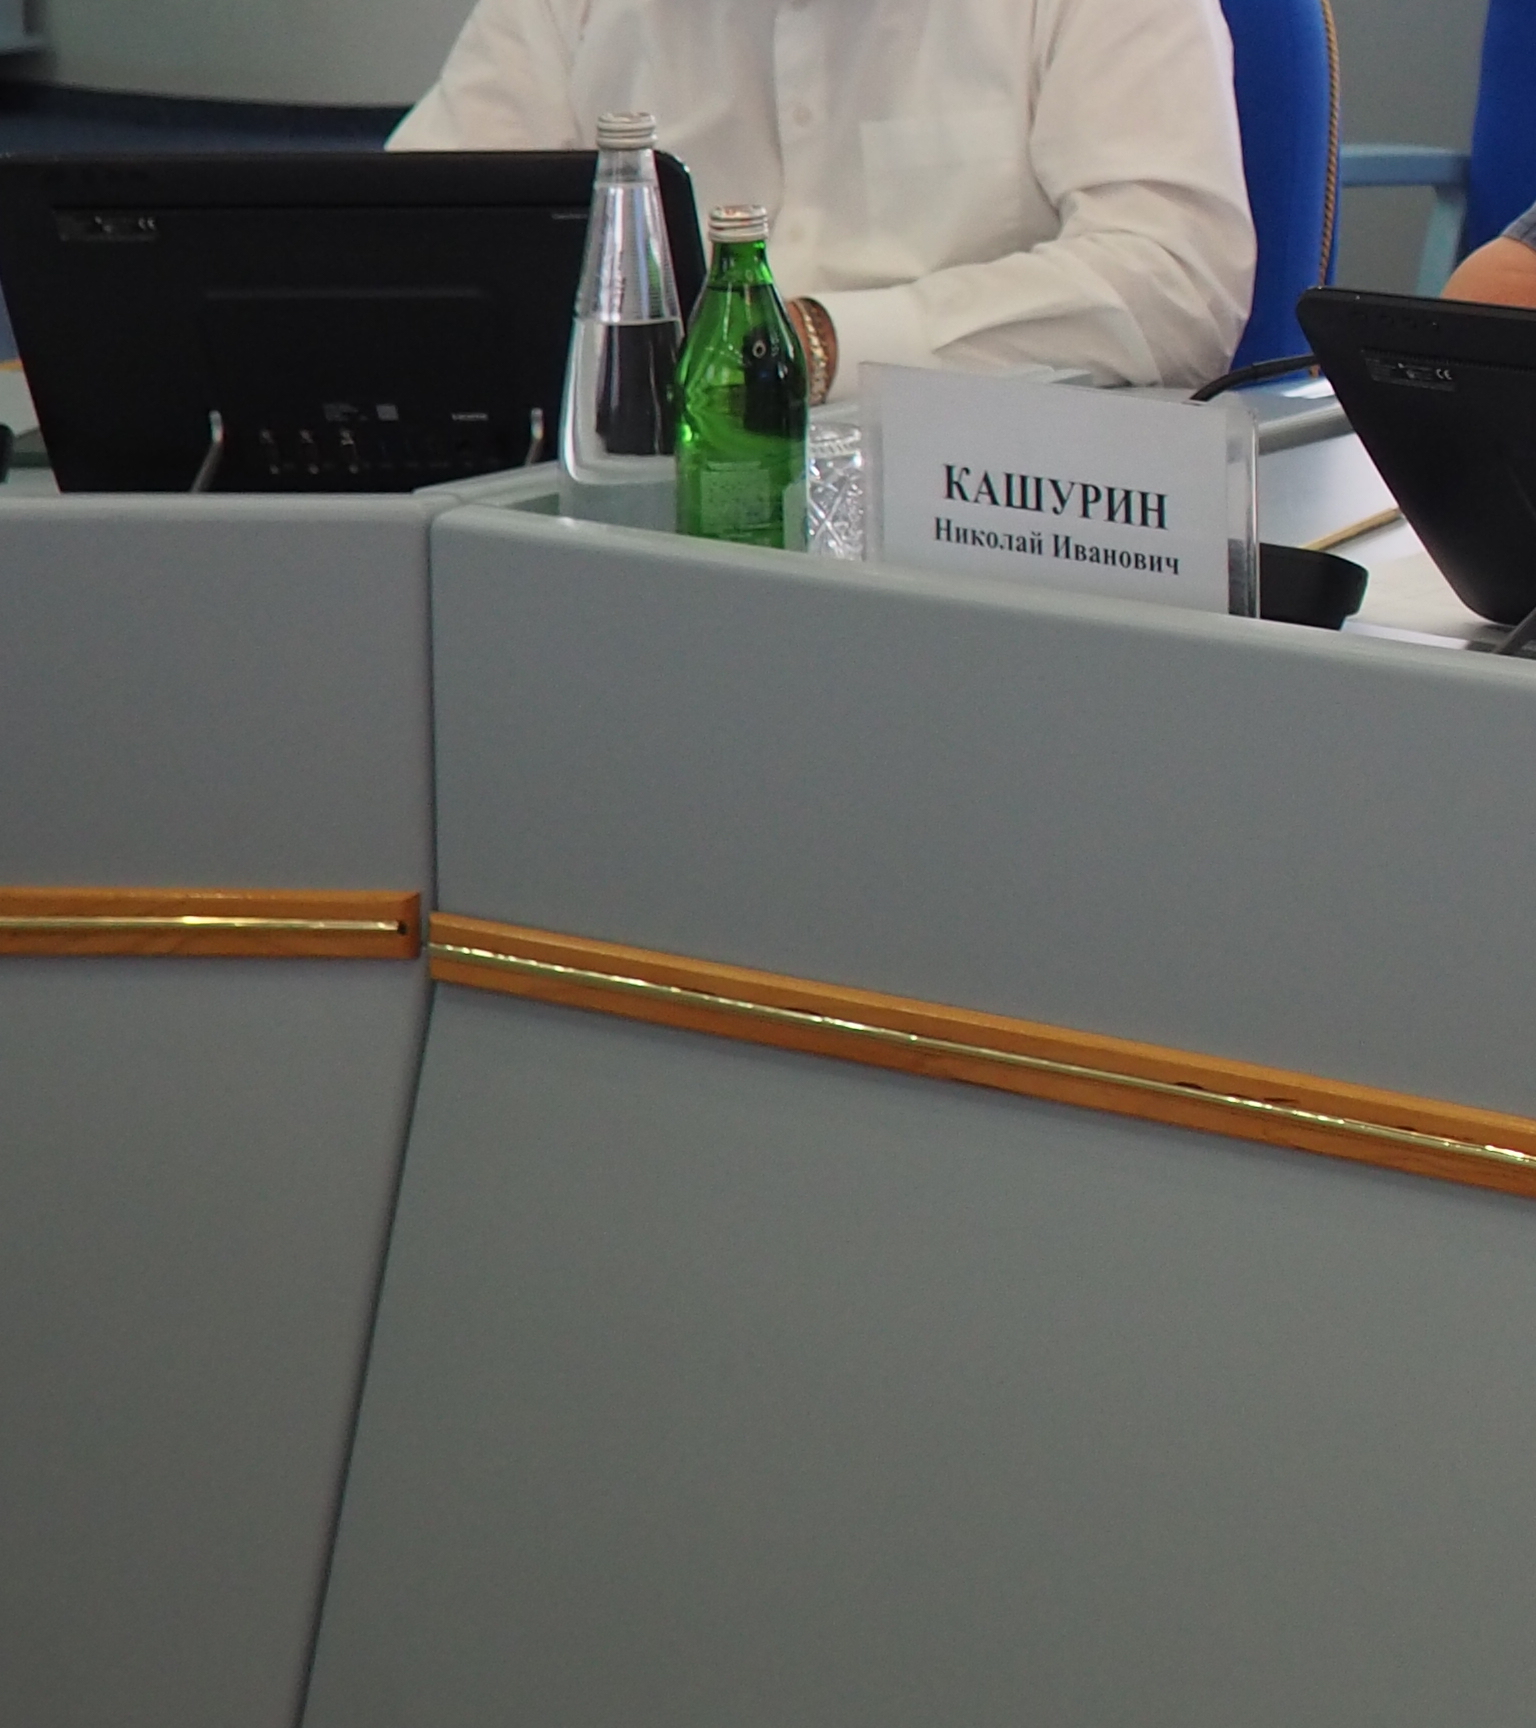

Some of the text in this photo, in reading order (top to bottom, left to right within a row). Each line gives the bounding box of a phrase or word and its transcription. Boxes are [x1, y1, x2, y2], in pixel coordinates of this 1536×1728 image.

[942, 463, 1169, 530] КАШУРИН
[934, 516, 1180, 576] Николай Иванович
